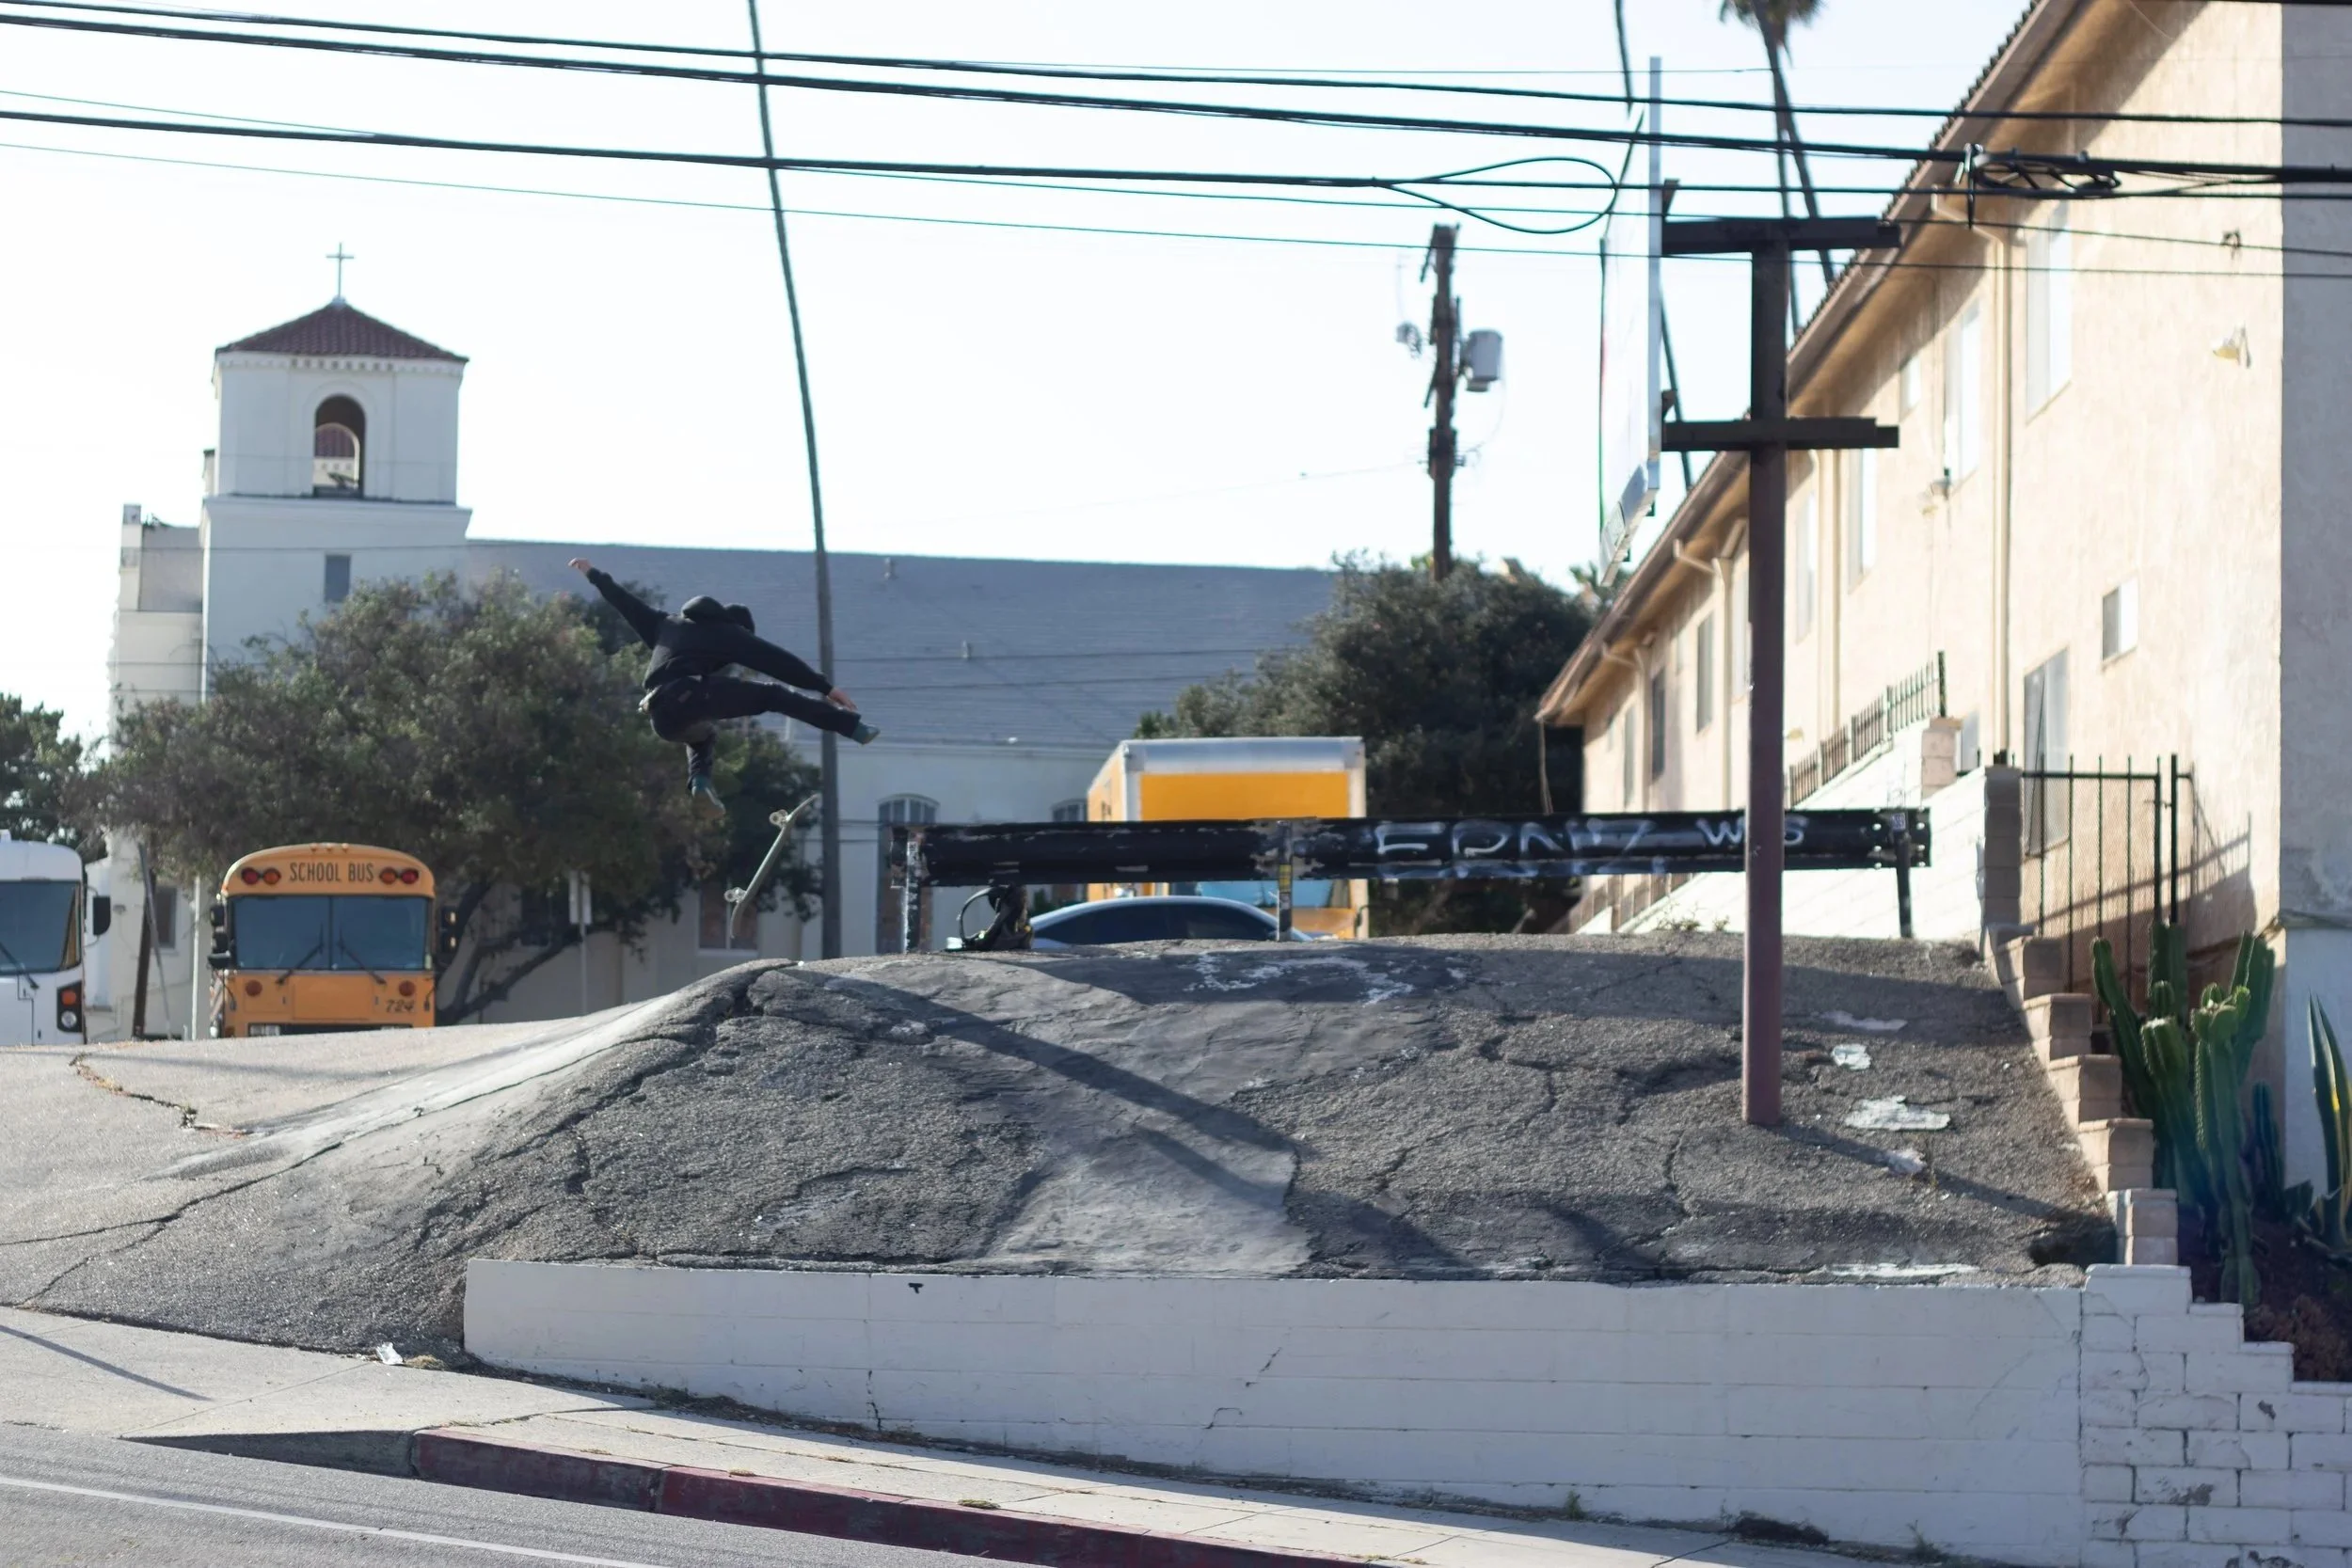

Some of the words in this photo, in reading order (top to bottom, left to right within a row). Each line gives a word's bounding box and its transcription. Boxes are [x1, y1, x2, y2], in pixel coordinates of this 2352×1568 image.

[289, 862, 341, 882] SCHOOL
[348, 862, 374, 882] BUS
[386, 999, 415, 1013] 724
